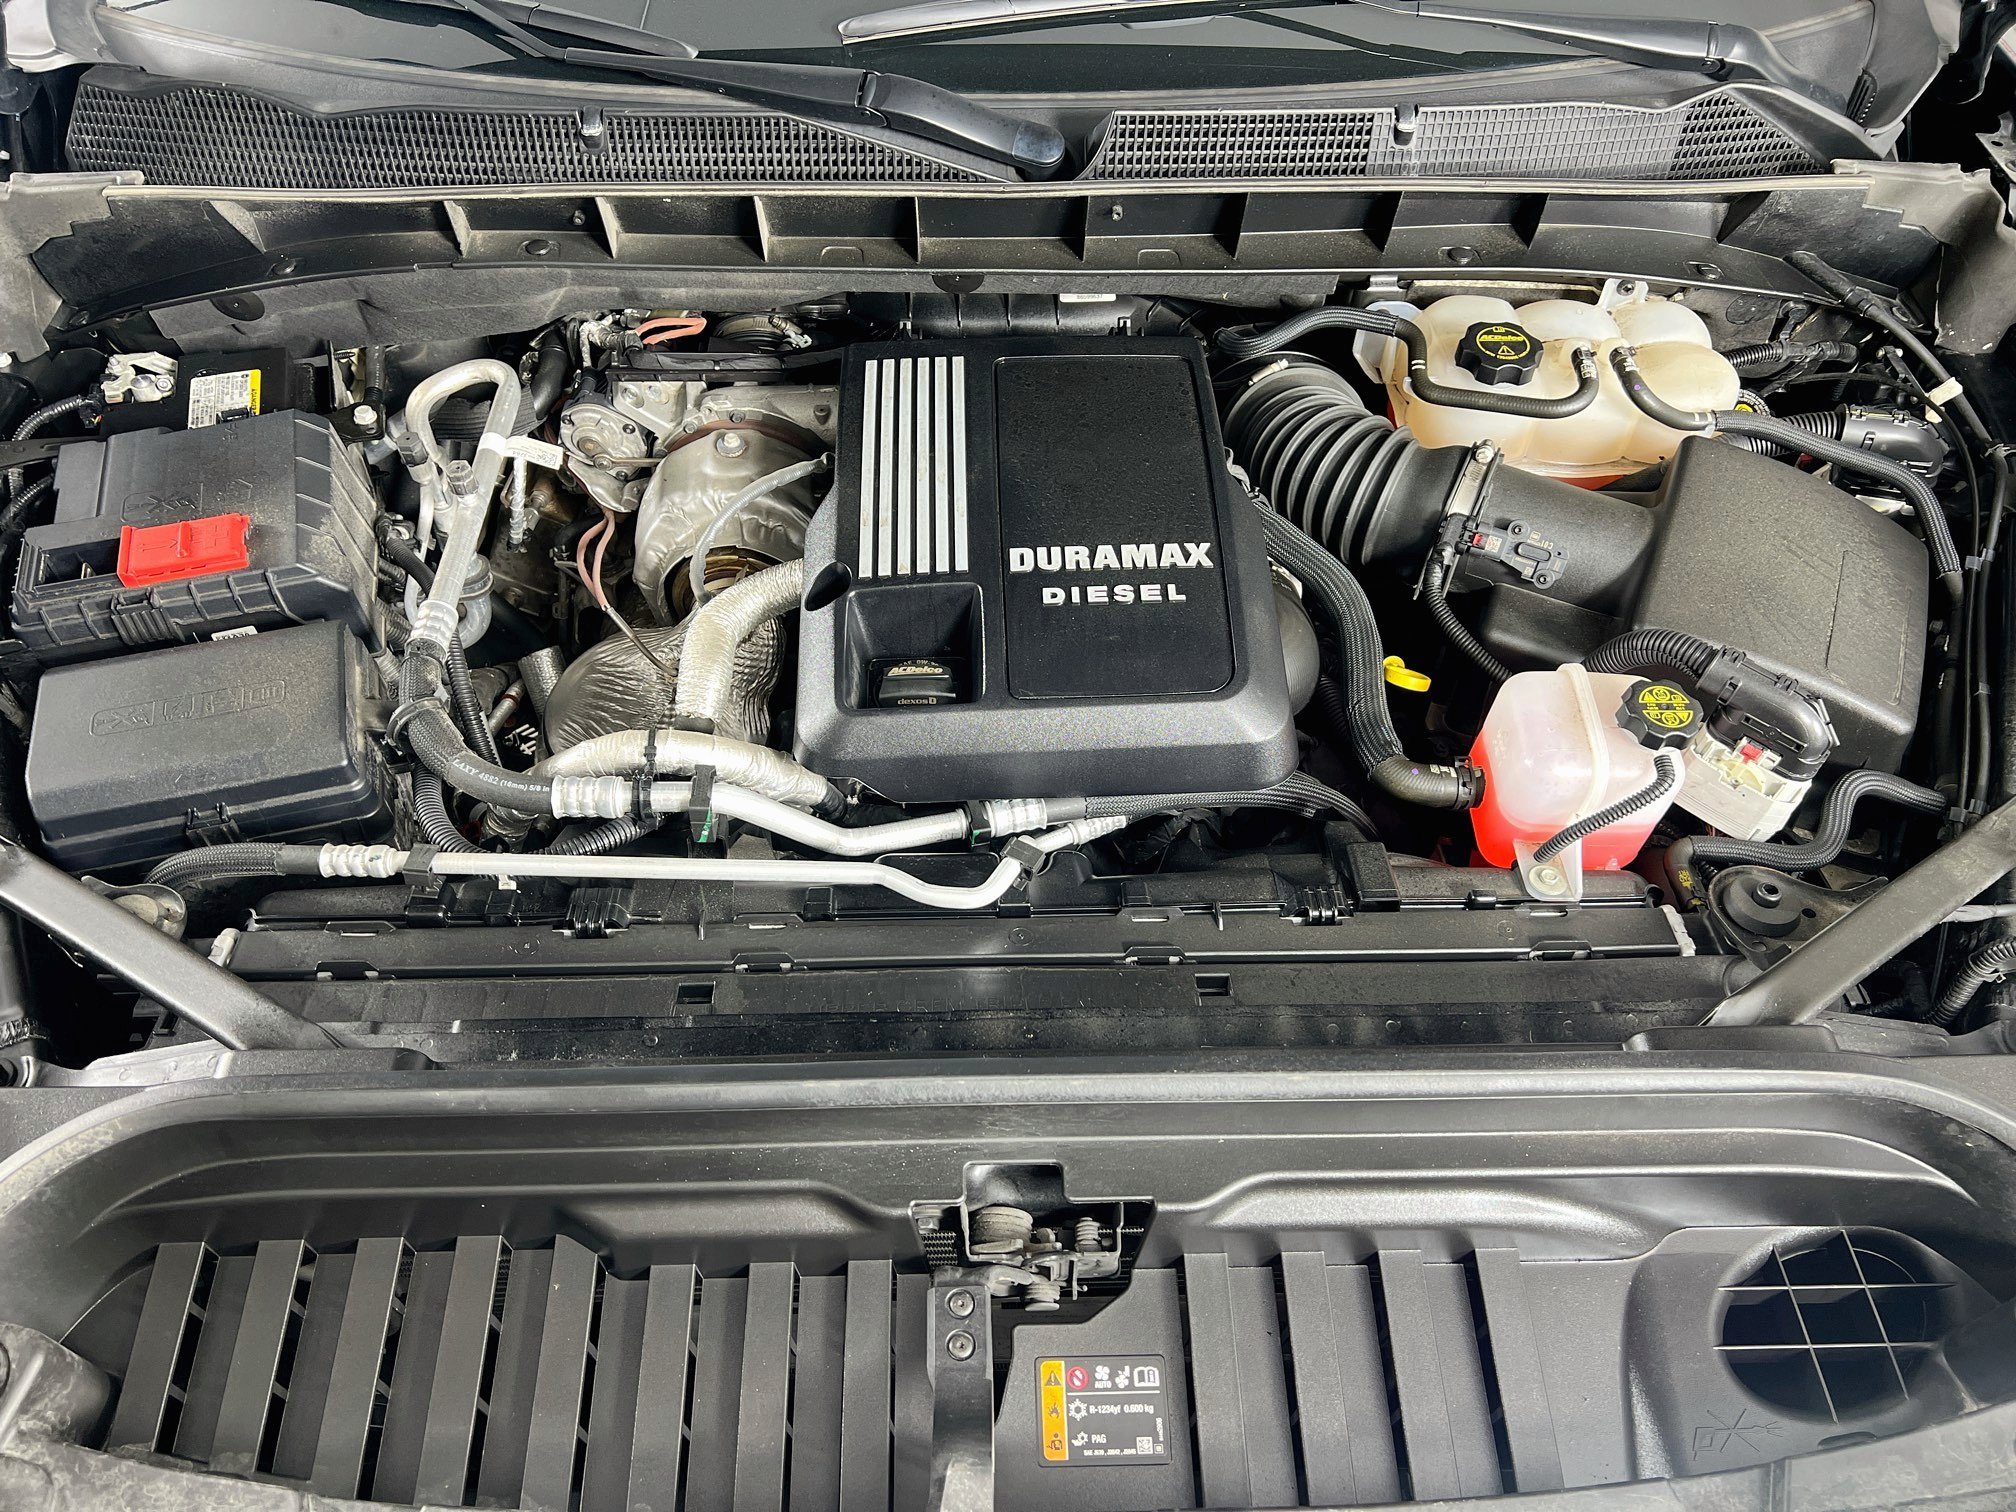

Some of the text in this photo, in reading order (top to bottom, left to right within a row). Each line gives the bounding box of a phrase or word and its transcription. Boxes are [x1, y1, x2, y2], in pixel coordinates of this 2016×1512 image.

[1479, 334, 1524, 342] ACDelco
[1009, 543, 1213, 573] DURAMAX
[1042, 584, 1186, 606] DIESEL
[887, 665, 944, 676] ACDelco
[500, 779, 528, 791] (16mm)
[1094, 1380, 1112, 1389] AUTO
[1089, 1404, 1121, 1415] R-1234yf
[1144, 1404, 1154, 1414] kg
[1091, 1434, 1107, 1444] PAG
